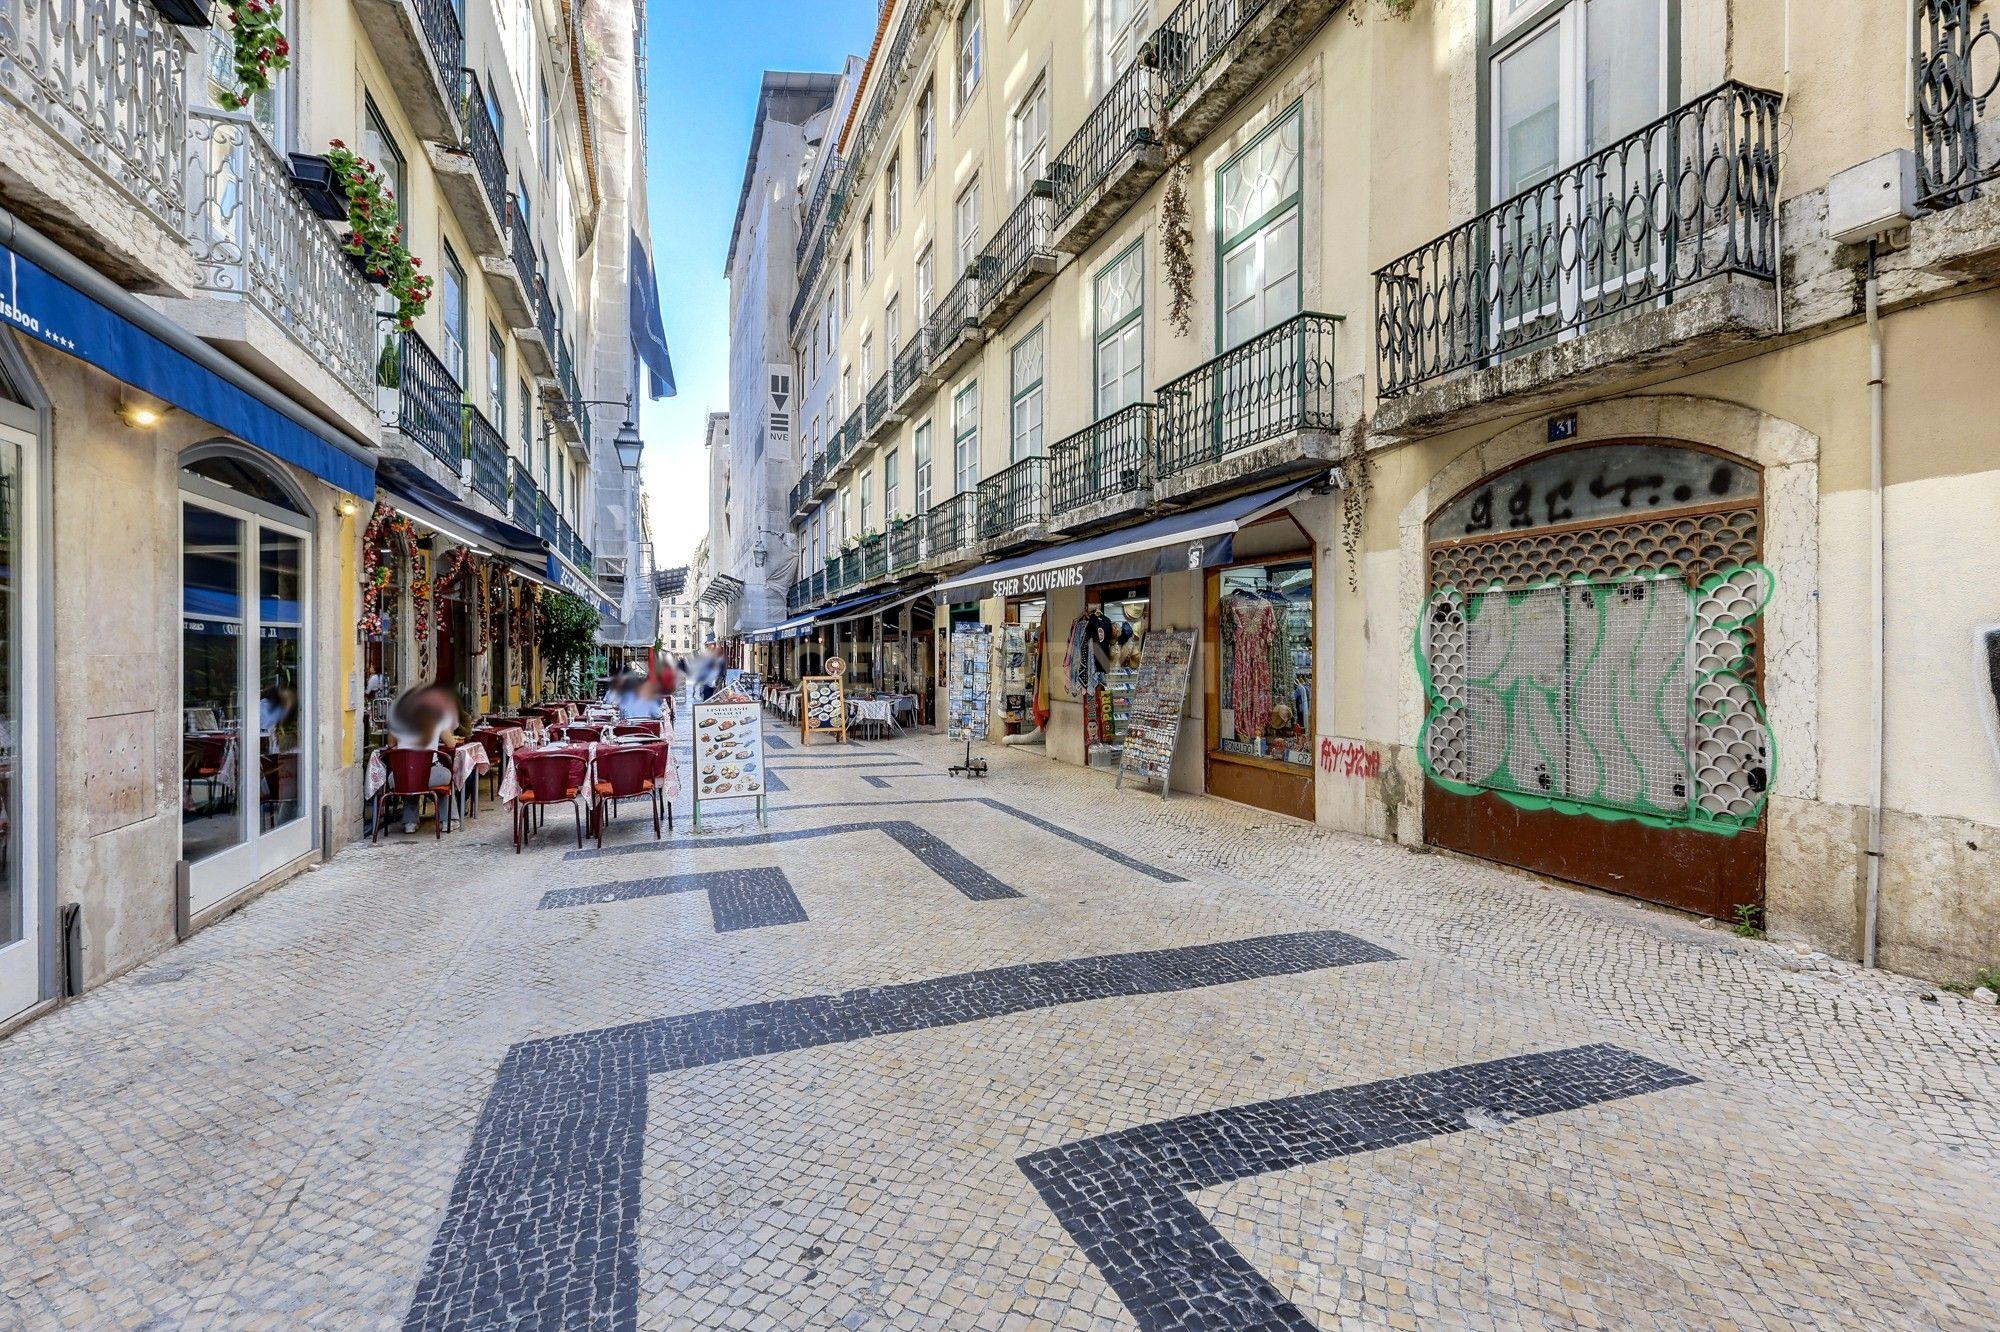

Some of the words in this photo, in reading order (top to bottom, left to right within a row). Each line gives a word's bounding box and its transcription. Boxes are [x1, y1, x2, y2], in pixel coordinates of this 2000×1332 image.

[1556, 418, 1573, 436] 31
[770, 432, 789, 442] NVE
[992, 578, 1019, 598] SEHER
[1022, 566, 1084, 594] SOUVENIRS
[1225, 740, 1252, 755] ONALDO
